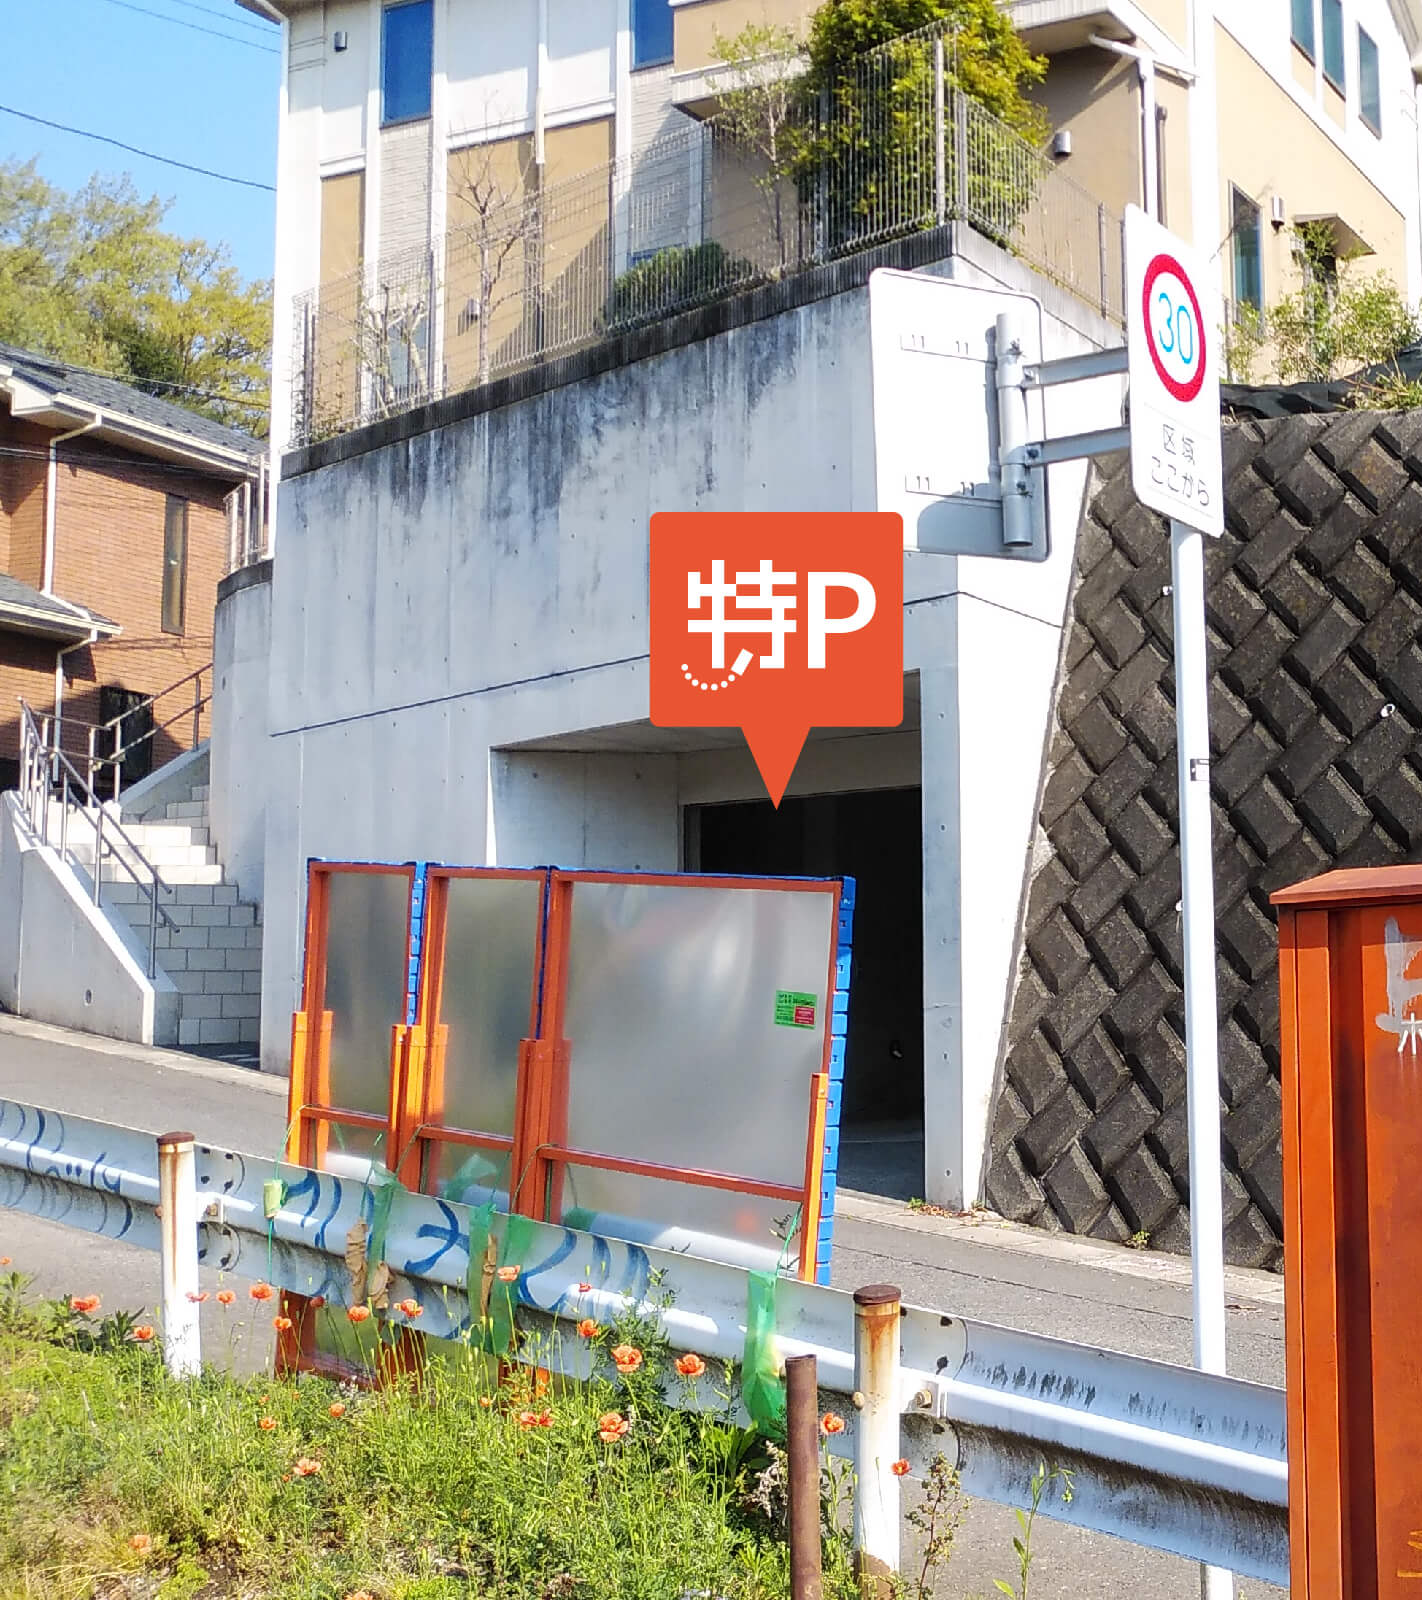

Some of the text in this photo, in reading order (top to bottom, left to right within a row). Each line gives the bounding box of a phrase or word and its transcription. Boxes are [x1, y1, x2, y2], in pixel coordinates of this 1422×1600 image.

[1159, 292, 1194, 365] 30
[1151, 455, 1210, 507] ここから
